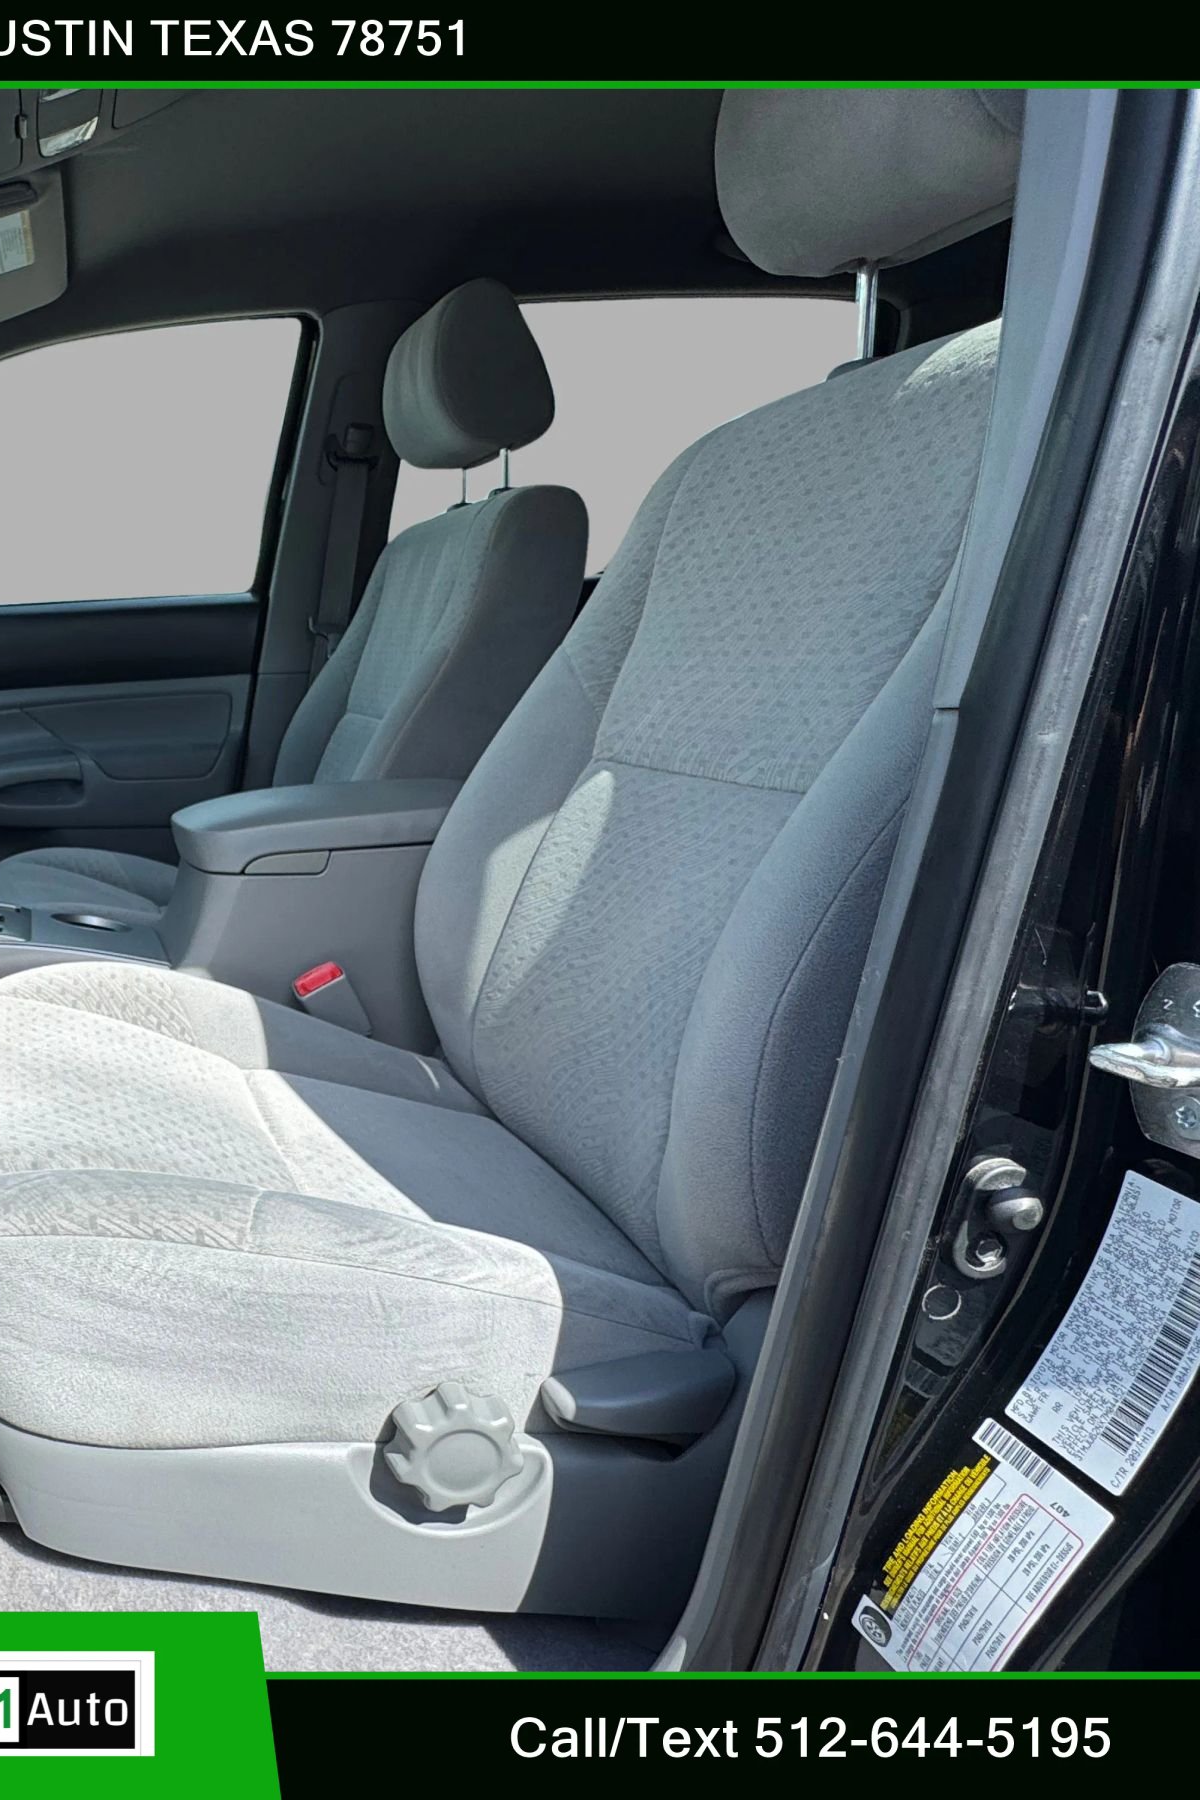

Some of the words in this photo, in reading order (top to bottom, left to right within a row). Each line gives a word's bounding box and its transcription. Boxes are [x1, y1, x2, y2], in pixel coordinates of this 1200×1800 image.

[1181, 1229, 1200, 1263] MEXICO
[1052, 1424, 1069, 1444] THIS
[1065, 1388, 1091, 1423] VEHICLE
[1166, 1196, 1182, 1226] MOTOR
[1029, 1355, 1052, 1384] TOYOTA
[1048, 1330, 1067, 1356] MOTOR
[1051, 1400, 1063, 1413] RR
[1058, 1416, 1085, 1450] VEHICLE
[1100, 1368, 1115, 1385] AND
[1066, 1426, 1089, 1456] EFFECT
[1086, 1412, 1098, 1425] ON
[1095, 1395, 1109, 1411] THE
[1105, 1373, 1123, 1394] DATE
[1119, 1359, 1130, 1372] OF
[1109, 1465, 1129, 1489] C/TR
[881, 1554, 896, 1573] TIRE
[892, 1540, 905, 1558] AND
[900, 1512, 925, 1544] LOADING
[920, 1468, 958, 1515] INFORMATION
[1048, 1499, 1071, 1519] 407
